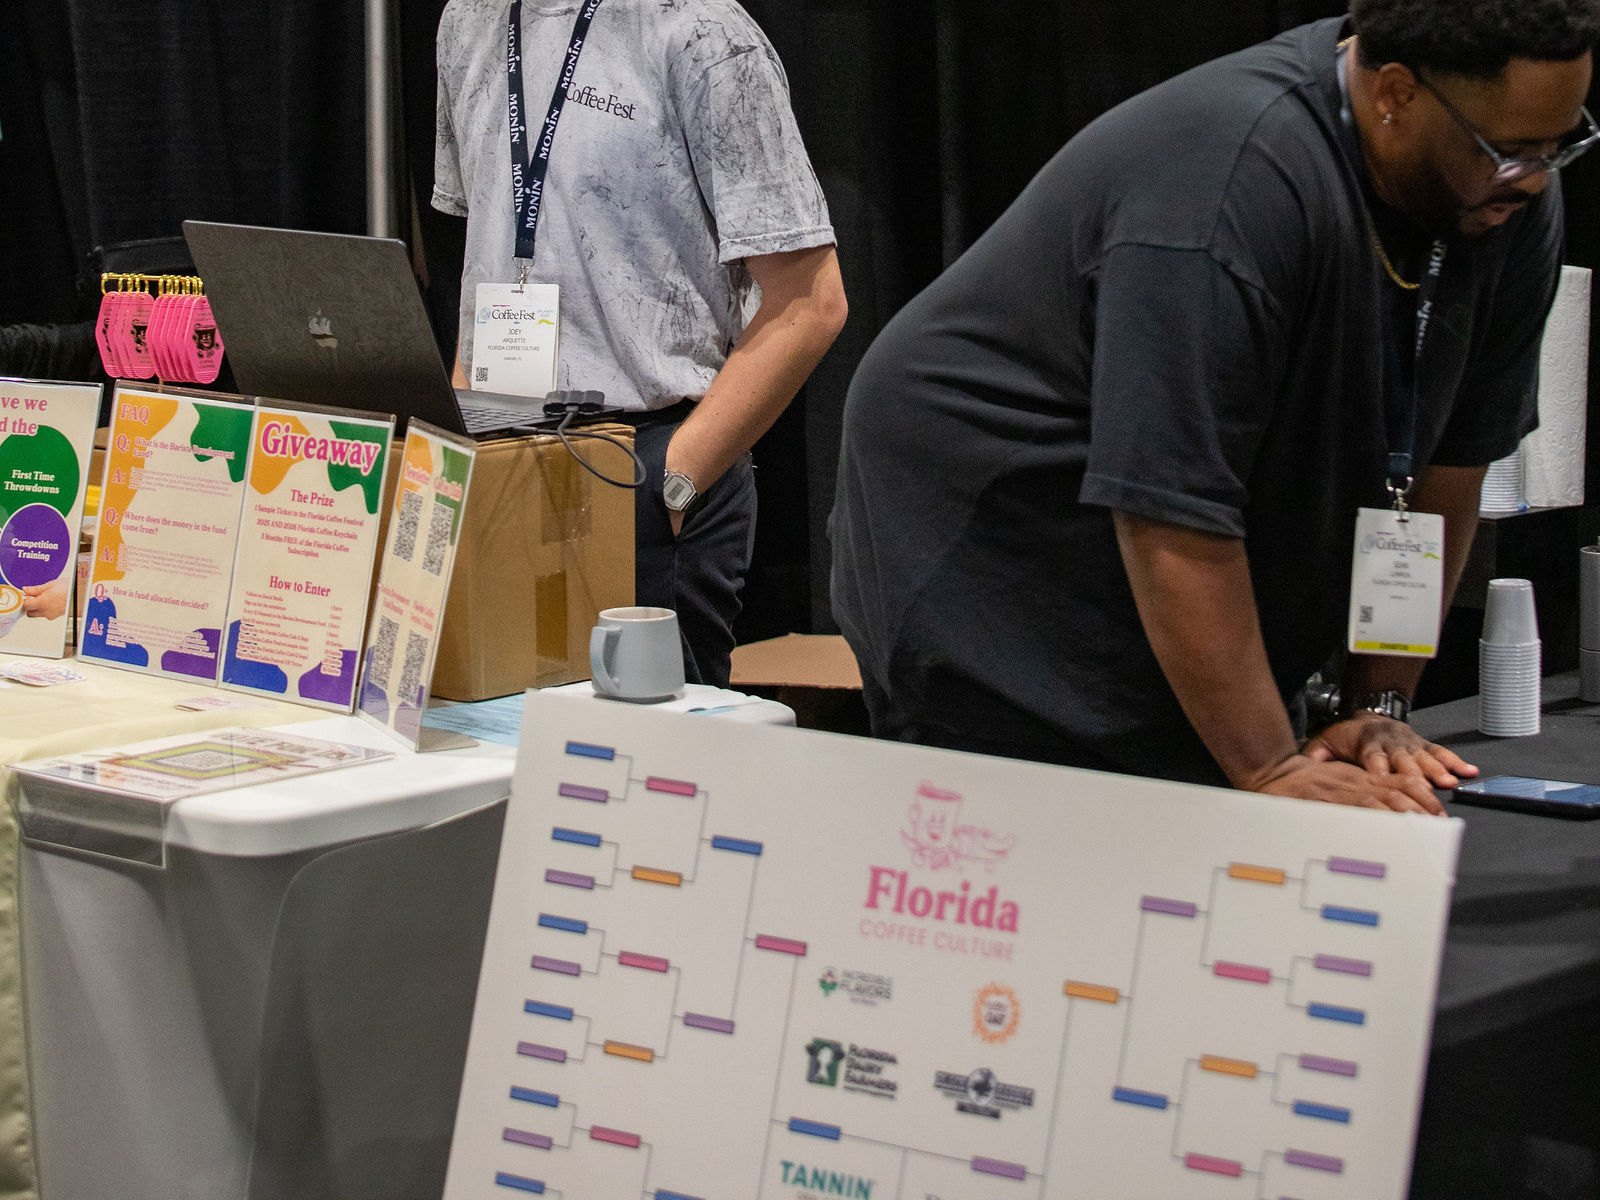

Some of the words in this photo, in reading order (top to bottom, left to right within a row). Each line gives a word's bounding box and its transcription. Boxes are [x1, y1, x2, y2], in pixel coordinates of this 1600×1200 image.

[508, 24, 521, 74] MONIN
[561, 37, 582, 89] MONIN
[509, 93, 526, 144] MONIN
[539, 108, 560, 159] MONIN
[526, 177, 542, 229] MONIN
[25, 398, 48, 411] we
[120, 403, 150, 425] FAQ
[12, 417, 38, 435] the
[262, 423, 380, 473] Giveaway
[11, 469, 32, 481] First
[33, 471, 55, 482] Time
[4, 481, 60, 494] Throwdowns
[291, 489, 308, 504] The
[310, 492, 335, 507] Prize
[124, 511, 145, 521] Where
[146, 514, 160, 524] does
[161, 516, 171, 526] the
[172, 519, 193, 531] money
[201, 522, 211, 532] the
[308, 511, 325, 521] Florida
[326, 514, 343, 523] Coffee
[122, 523, 138, 532] come
[140, 525, 159, 536] from?
[298, 524, 315, 534] Florida
[316, 526, 333, 536] Coffee
[11, 538, 59, 551] Competition
[313, 540, 332, 550] Florida
[17, 550, 50, 562] Training
[269, 575, 292, 590] How
[293, 581, 304, 593] to
[304, 581, 331, 597] Enter
[112, 587, 127, 597] How
[150, 593, 180, 607] allocation
[180, 598, 209, 611] decided?
[863, 865, 1019, 933] Florida
[858, 917, 927, 947] COFFEE
[934, 930, 1014, 961] CULTURE
[780, 1159, 874, 1200] TANNIN
